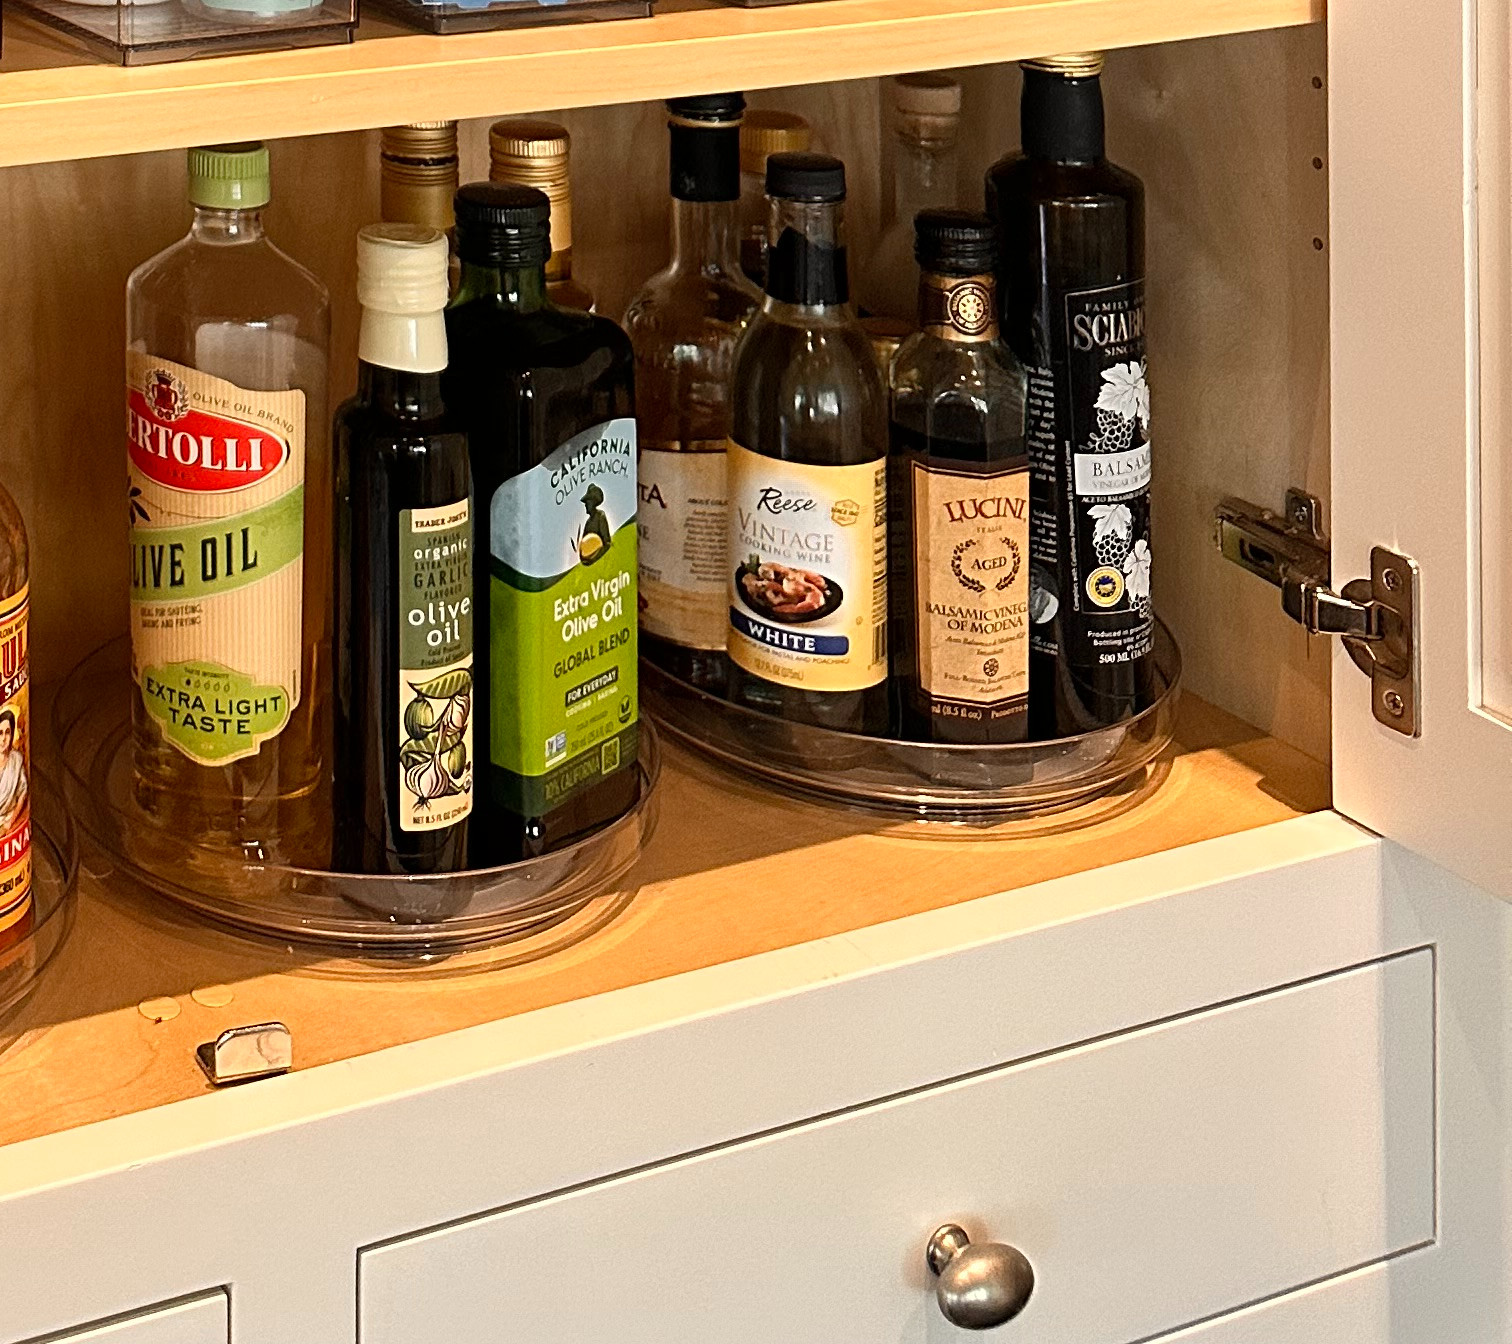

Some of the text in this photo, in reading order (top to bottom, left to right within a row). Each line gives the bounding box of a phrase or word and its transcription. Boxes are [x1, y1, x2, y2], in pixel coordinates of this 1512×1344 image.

[550, 439, 631, 488] CALIFORNIA
[555, 472, 587, 506] OLIVE
[757, 488, 816, 514] Reese
[943, 498, 1025, 522] LUCINI
[201, 527, 258, 581] OIL
[971, 555, 1007, 570] AGED
[408, 597, 471, 627] olive
[554, 571, 630, 621] Extra Virgin
[427, 621, 460, 646] oil
[562, 597, 623, 641] Olive Oil
[748, 622, 816, 652] WHITE
[554, 628, 631, 679] GLOBAL BLEND
[147, 678, 282, 715] EXTRA LIGHT
[169, 707, 251, 735] TASTE
